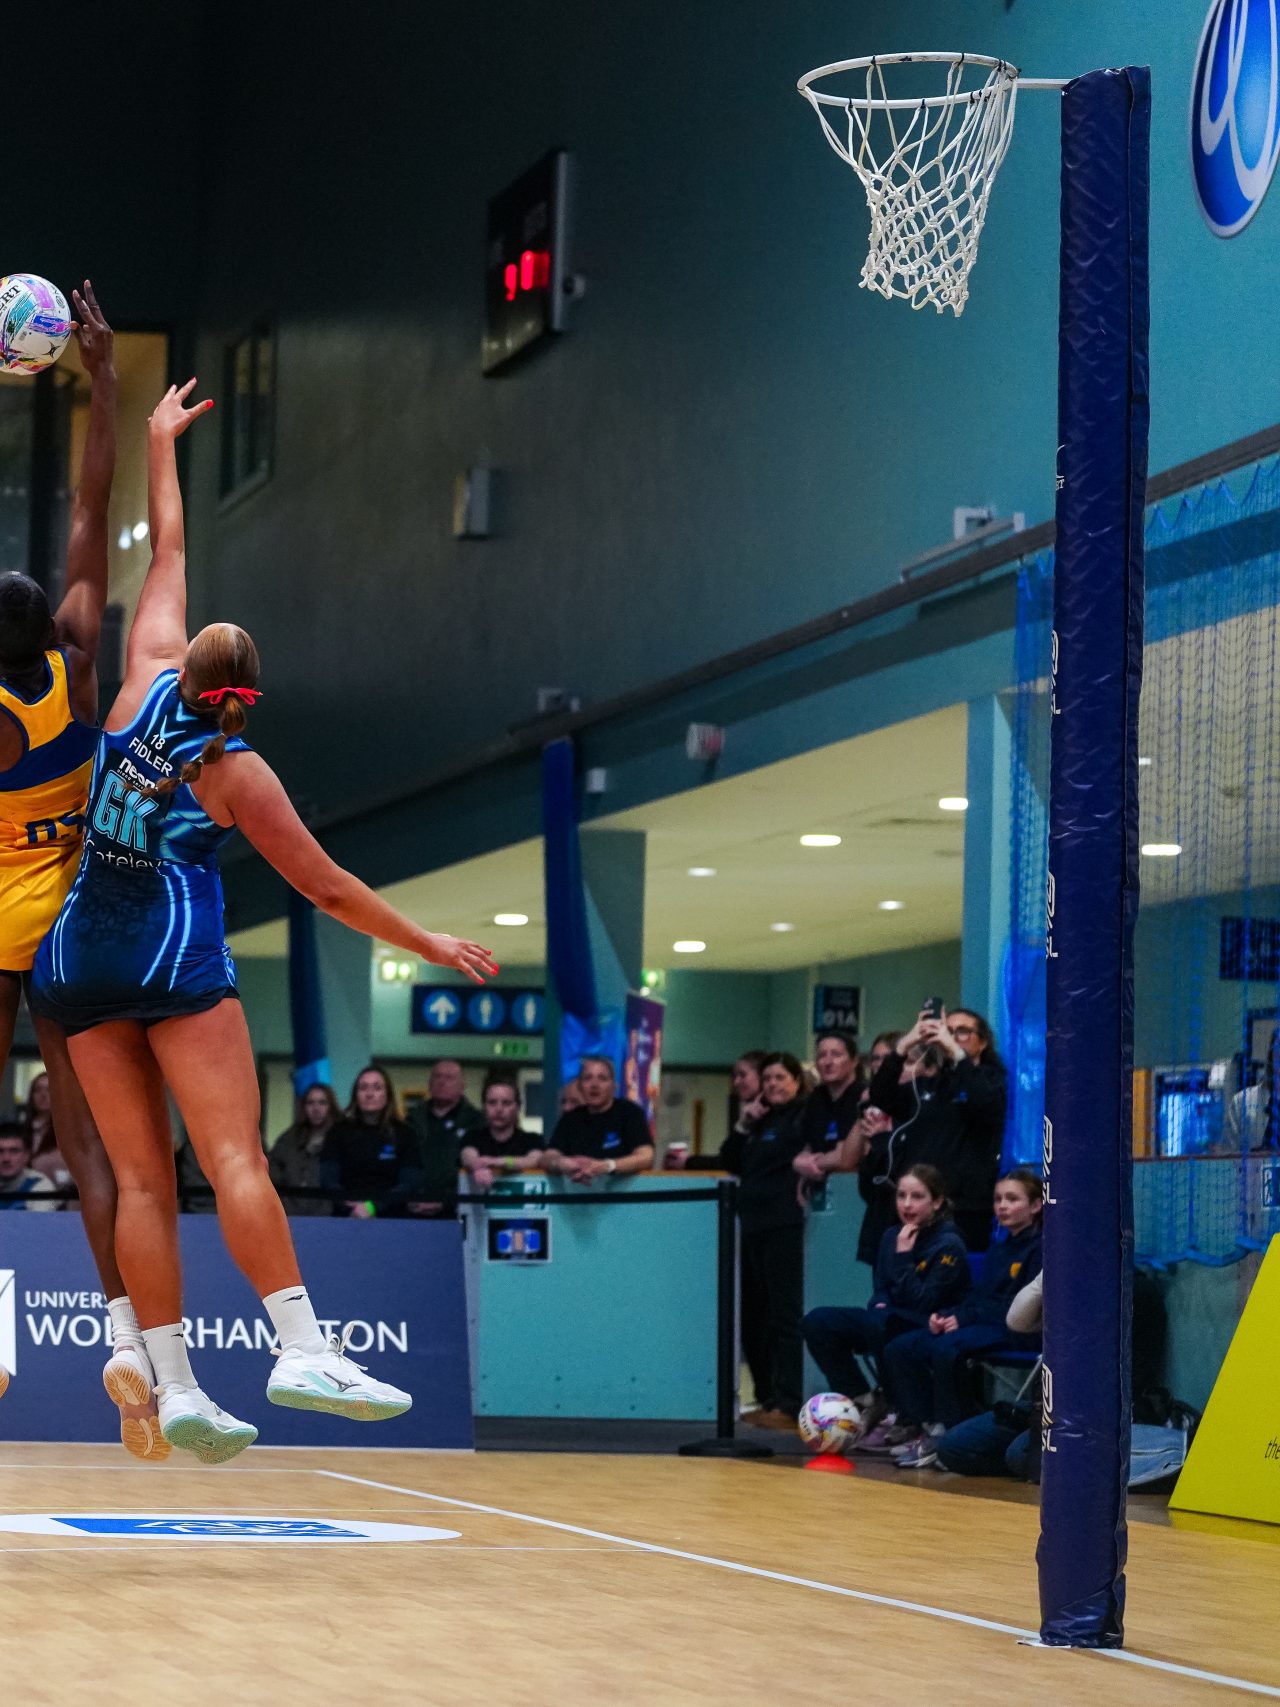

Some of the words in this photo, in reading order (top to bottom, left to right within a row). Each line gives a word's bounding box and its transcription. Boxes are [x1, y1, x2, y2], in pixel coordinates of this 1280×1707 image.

[128, 736, 173, 778] FIDLER
[150, 733, 166, 750] 18
[118, 757, 157, 790] neon
[93, 769, 160, 853] GK
[25, 1313, 409, 1353] WOLRHAMTON
